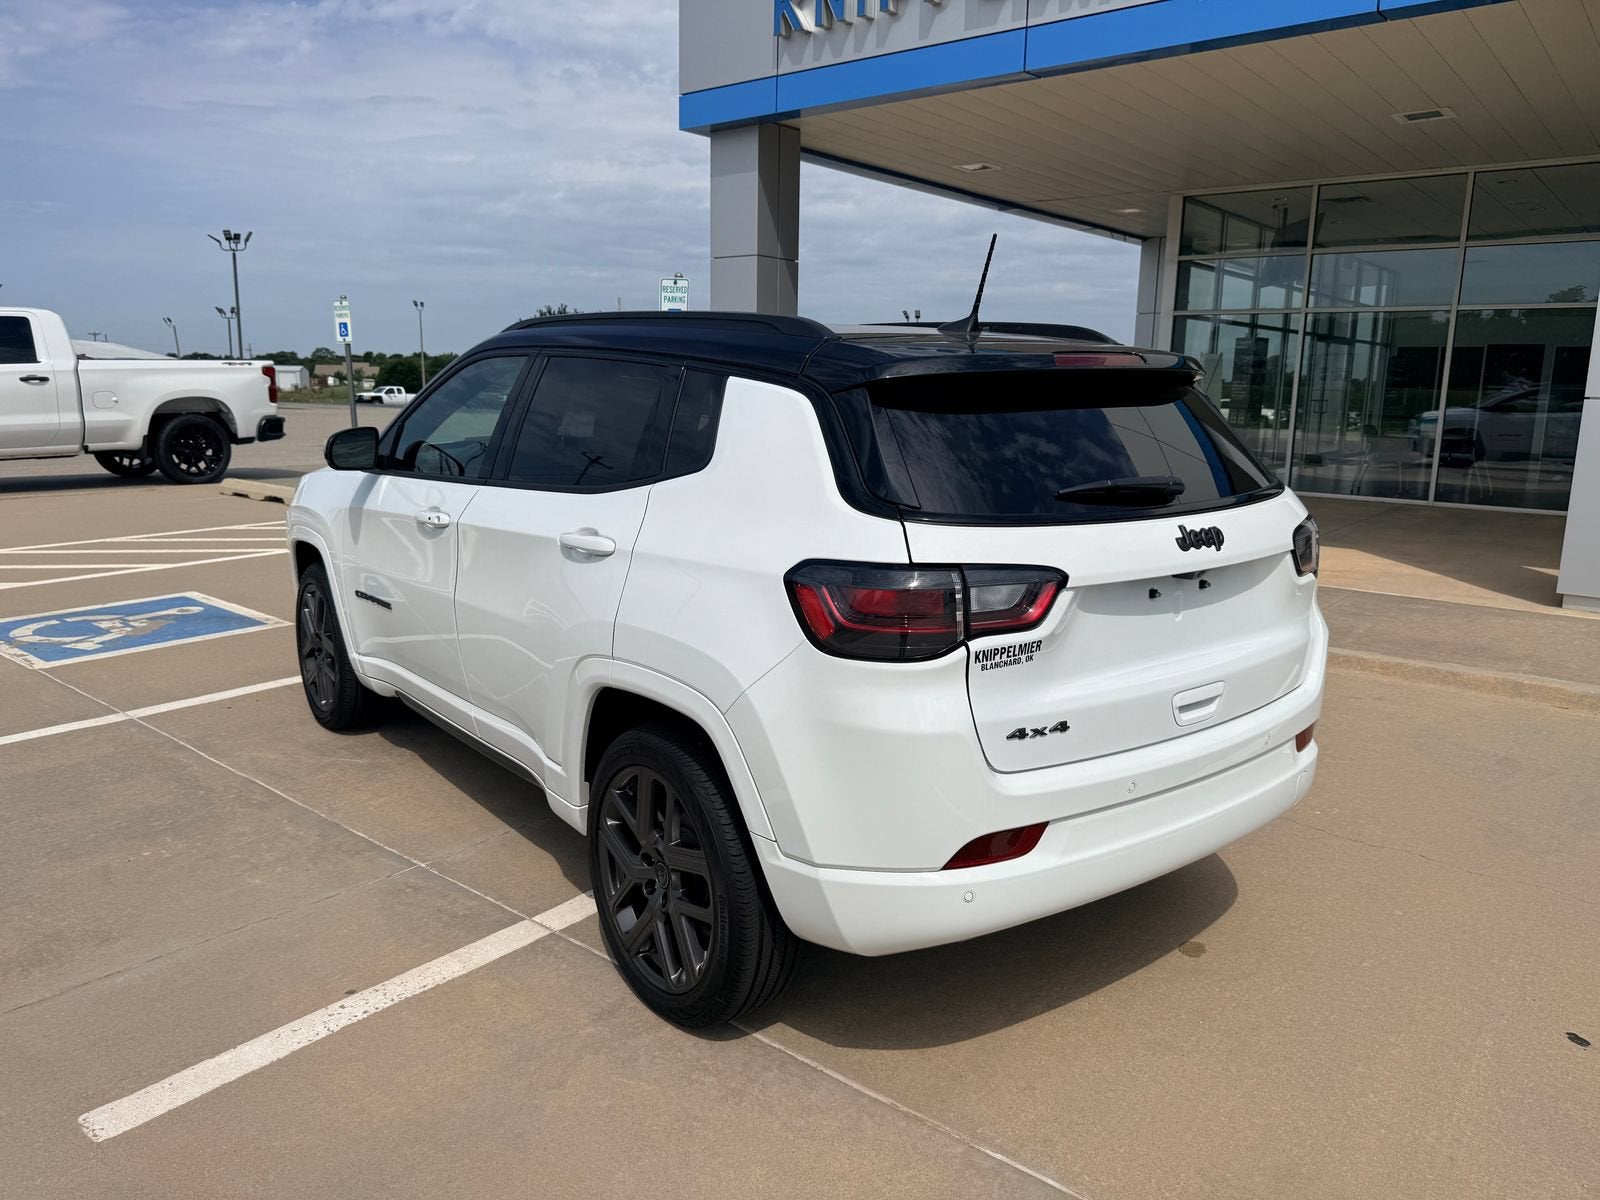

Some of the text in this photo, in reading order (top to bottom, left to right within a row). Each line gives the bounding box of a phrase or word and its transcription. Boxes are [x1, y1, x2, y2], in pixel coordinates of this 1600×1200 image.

[1175, 524, 1224, 552] Jeep
[974, 640, 1043, 664] KNIPPELMIER
[980, 654, 1034, 672] BLANCHARD, OK
